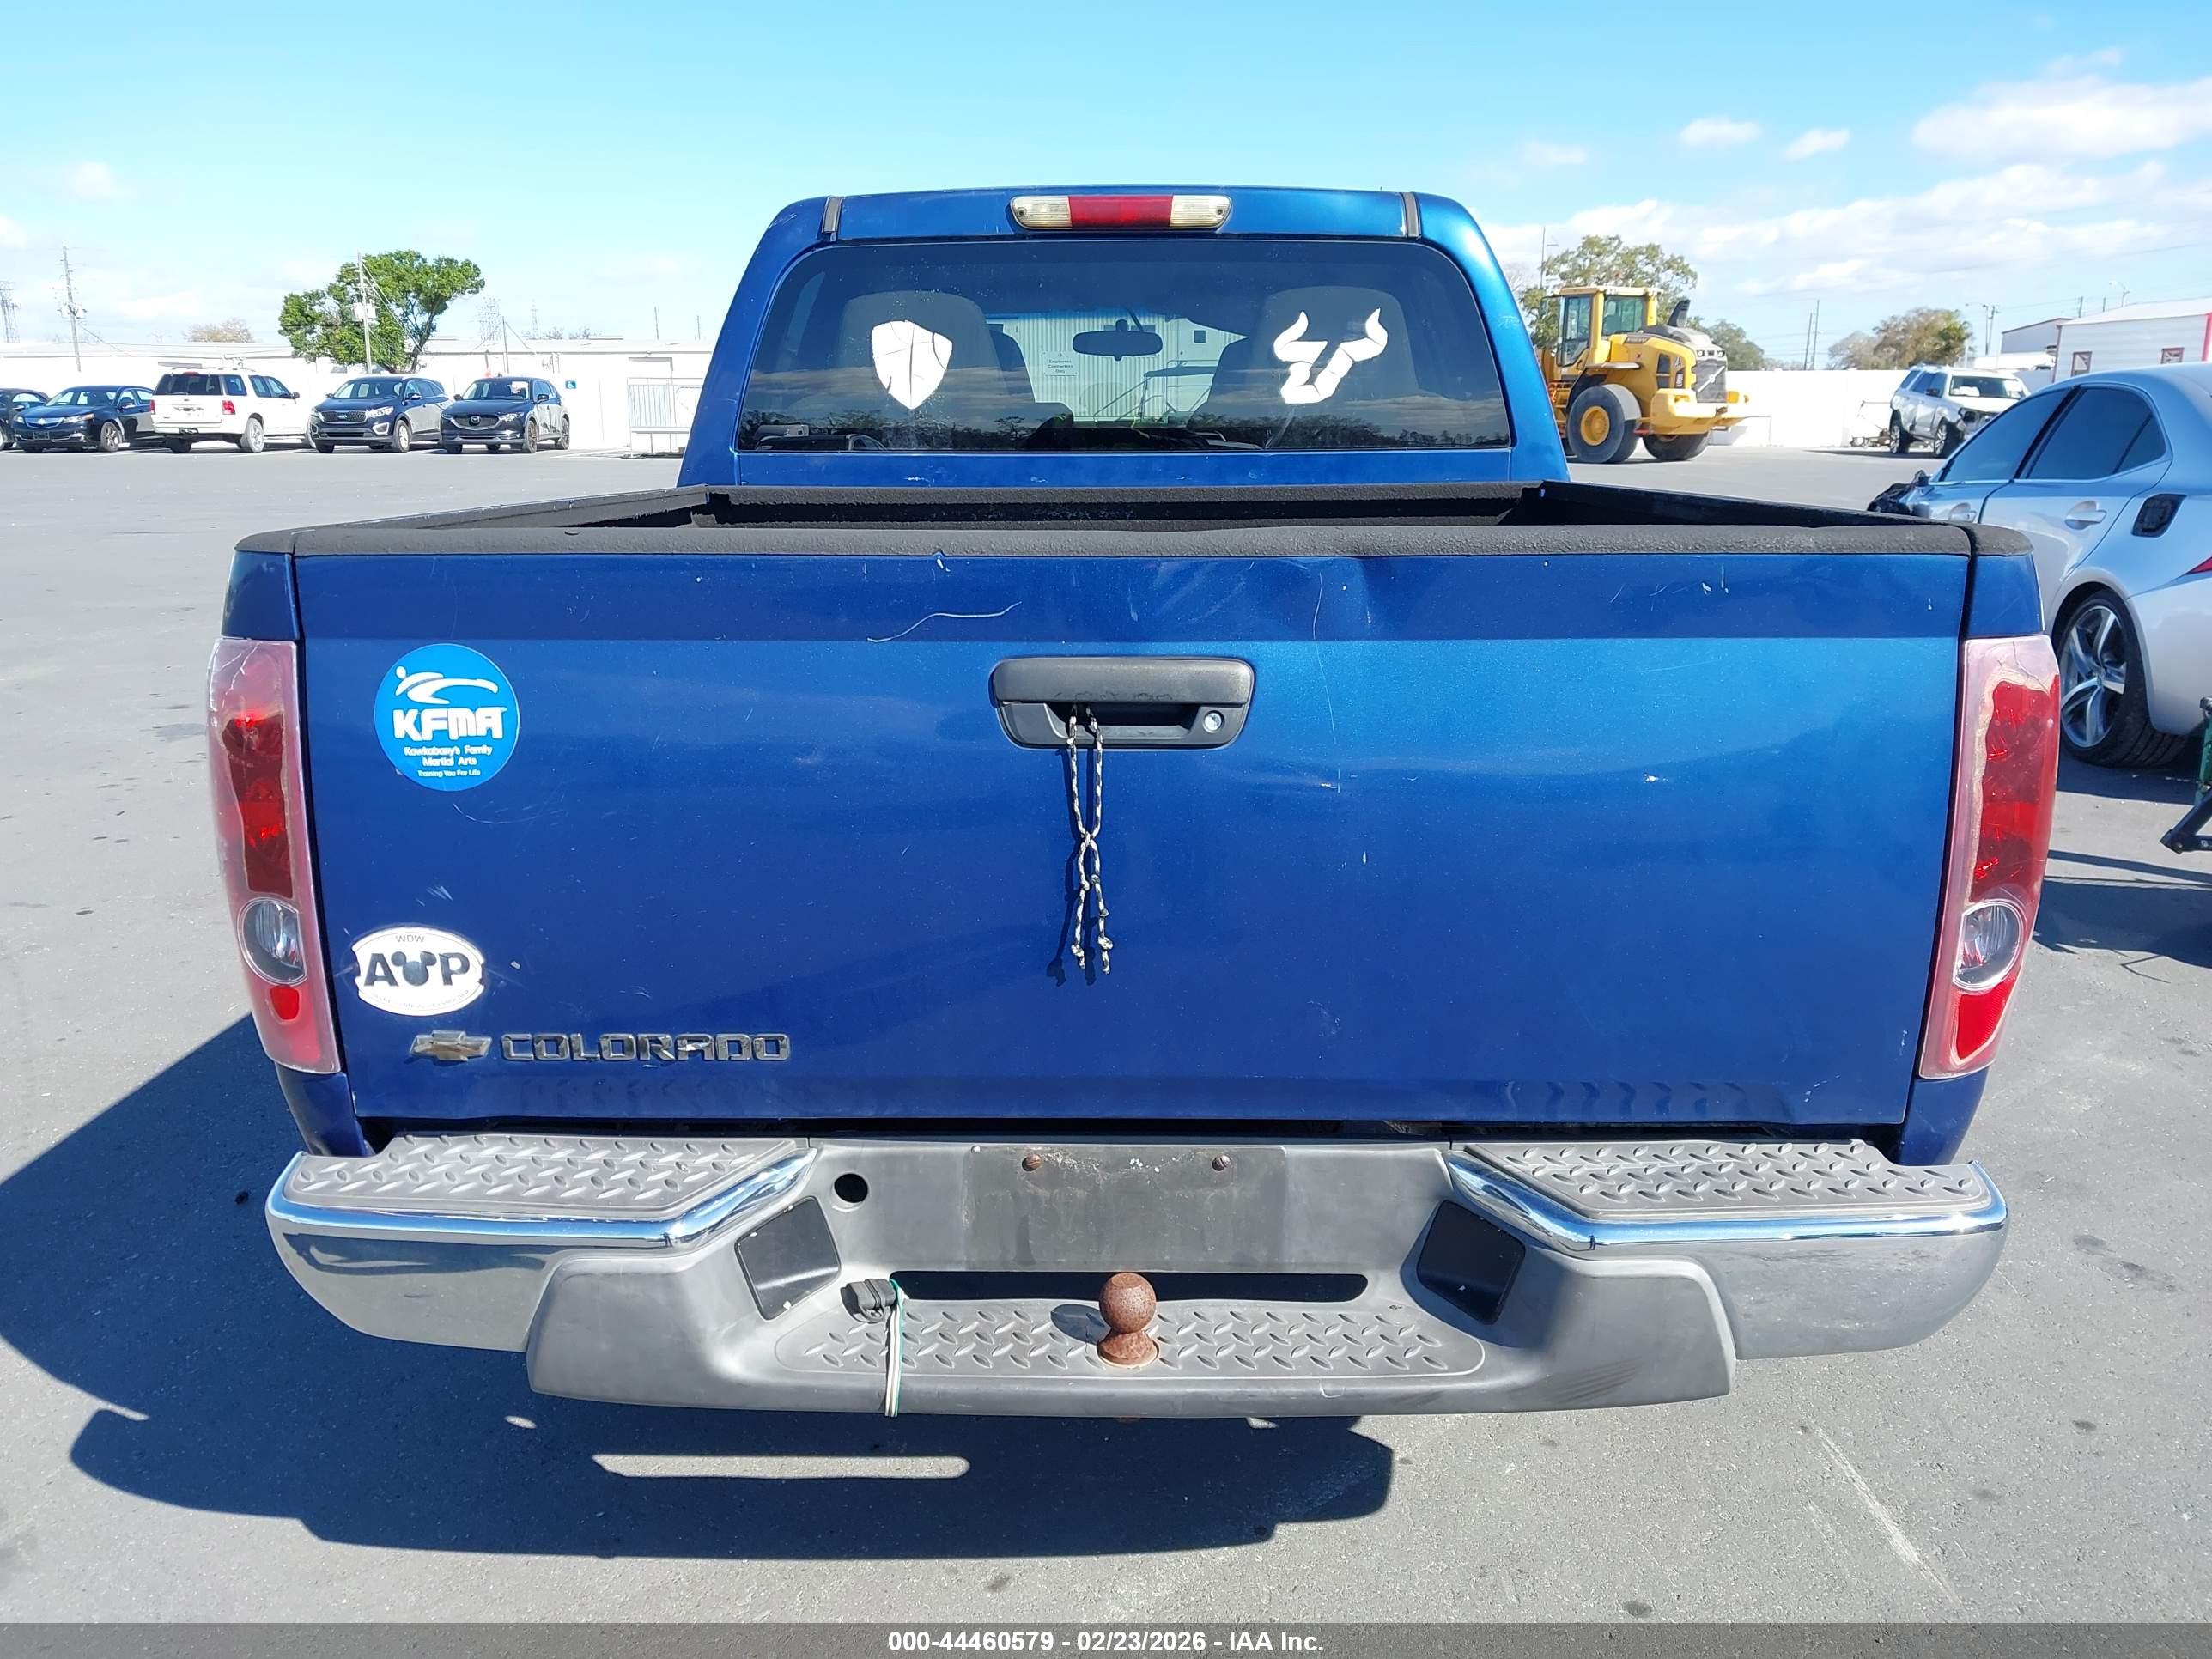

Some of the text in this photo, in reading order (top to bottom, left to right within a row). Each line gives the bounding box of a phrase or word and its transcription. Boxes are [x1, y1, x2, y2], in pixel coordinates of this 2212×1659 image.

[392, 707, 507, 741] KFMA
[464, 744, 493, 756] Family
[422, 756, 477, 766] Martial Arts
[417, 769, 443, 778] Training
[395, 934, 425, 943] WDW
[501, 1033, 791, 1061] COLORADO
